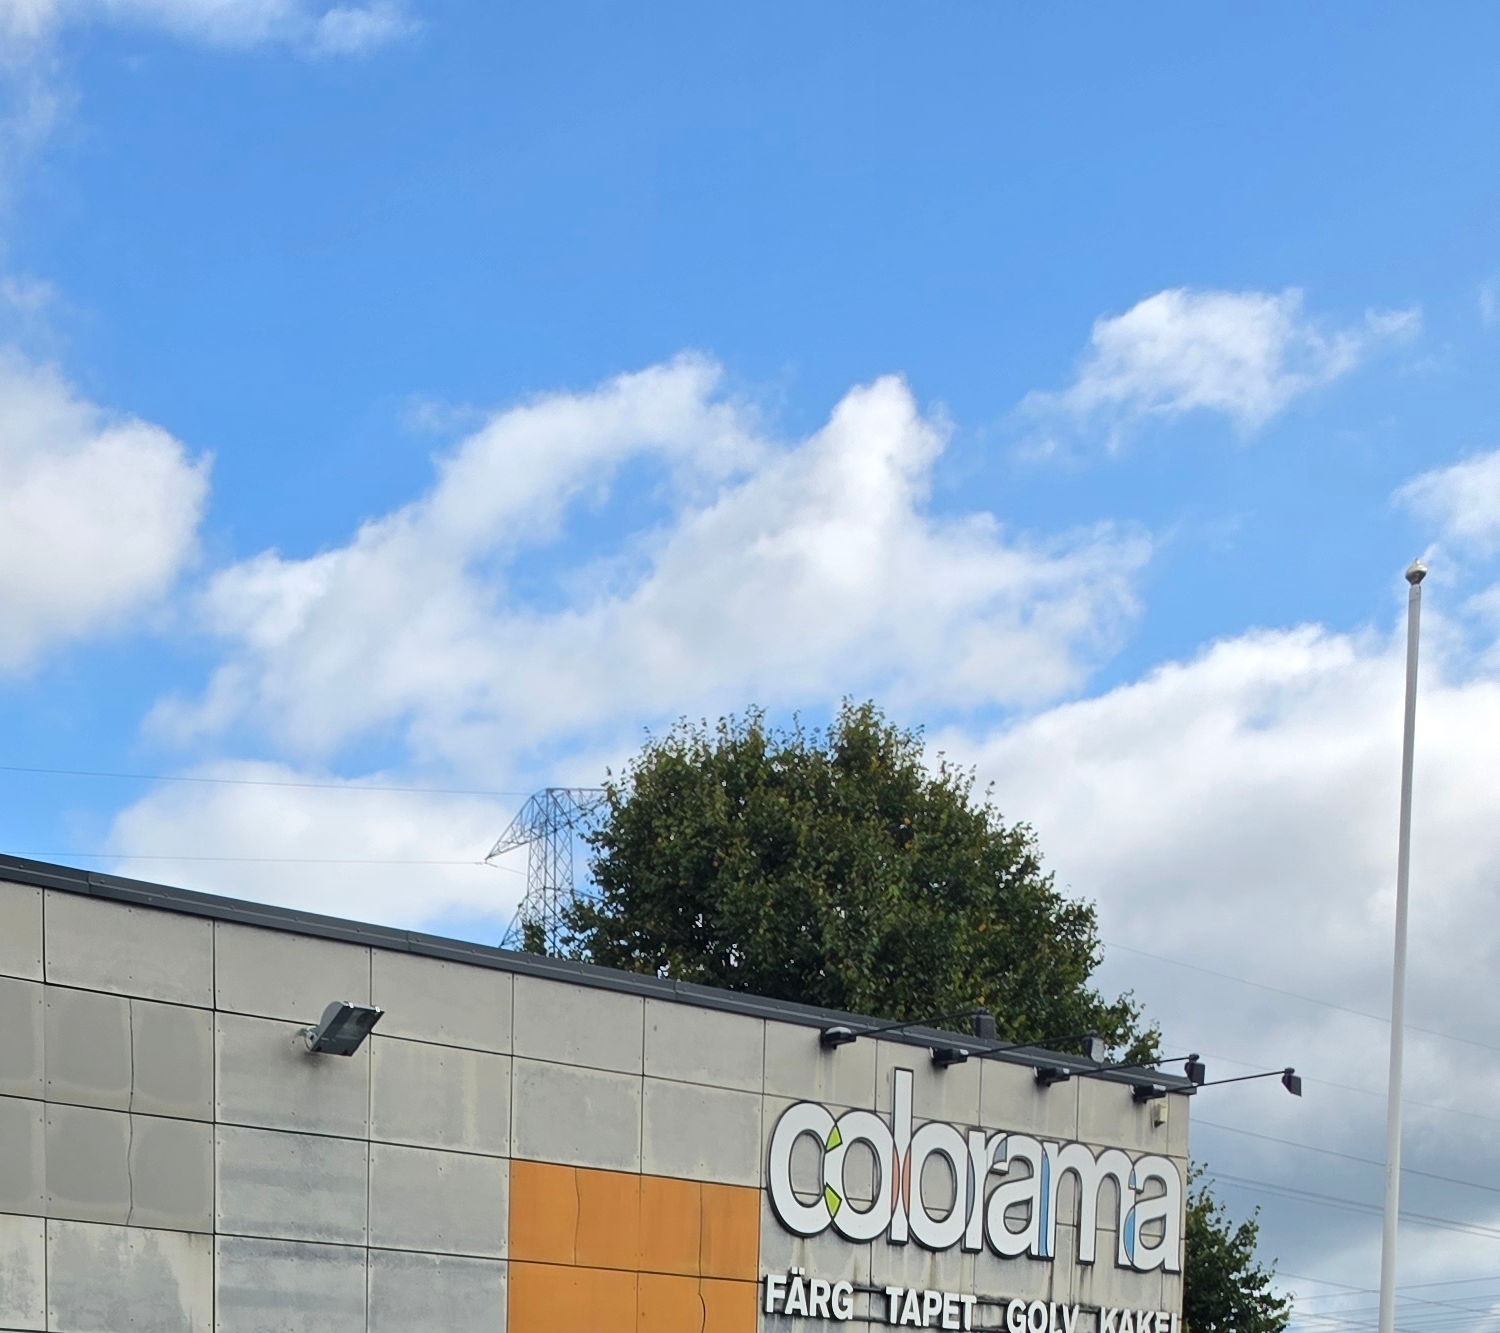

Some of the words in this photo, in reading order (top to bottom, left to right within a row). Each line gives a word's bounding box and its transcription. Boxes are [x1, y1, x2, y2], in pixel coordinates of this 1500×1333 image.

[768, 1067, 1181, 1273] colorama
[765, 1267, 854, 1320] FÄRG
[886, 1286, 977, 1331] TAPET
